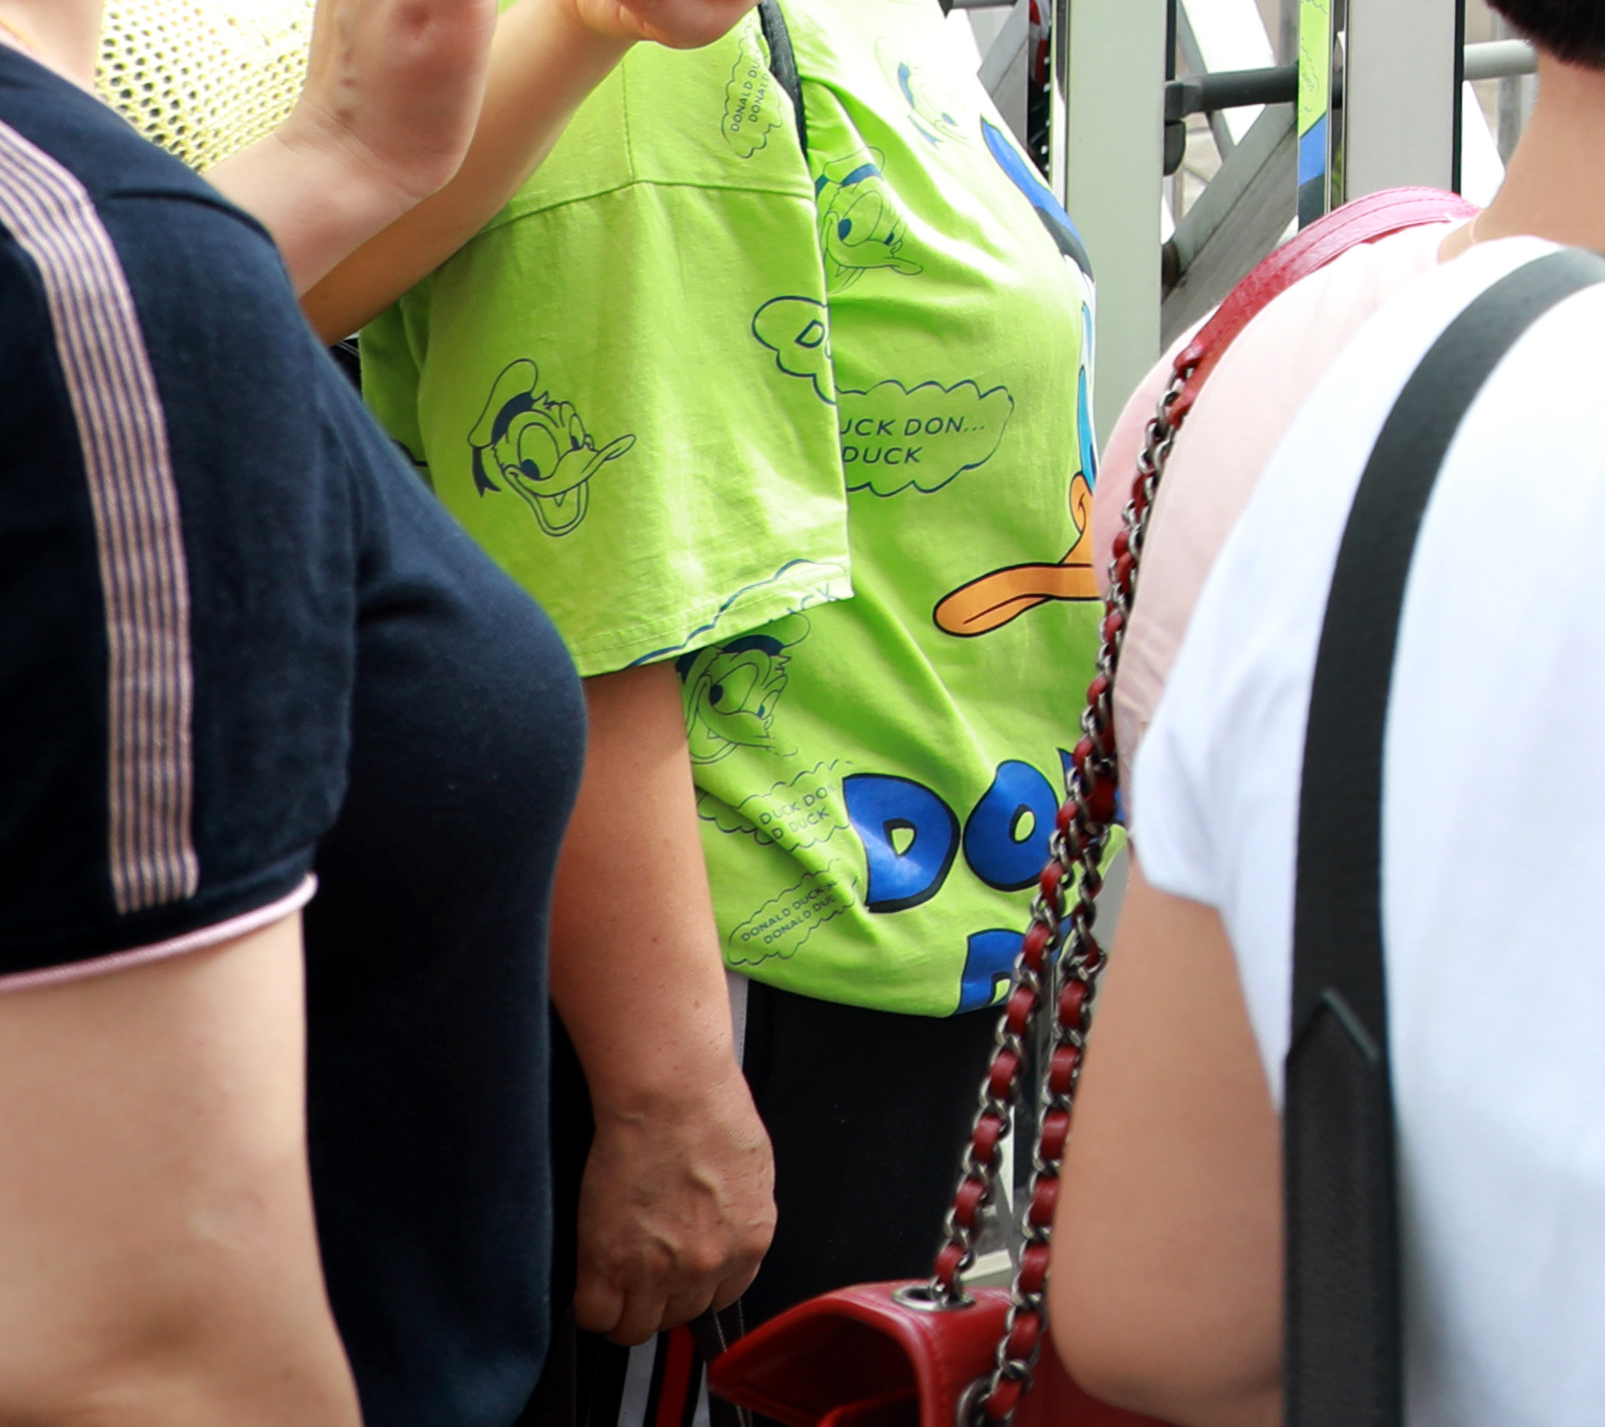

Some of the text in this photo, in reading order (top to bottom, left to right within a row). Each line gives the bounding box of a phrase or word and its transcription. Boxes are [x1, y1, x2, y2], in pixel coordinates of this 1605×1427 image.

[730, 81, 753, 132] DONALD
[748, 73, 770, 123] DONALD
[903, 416, 985, 437] DON...
[741, 908, 791, 943] DONALD
[763, 910, 812, 945] DONALD
